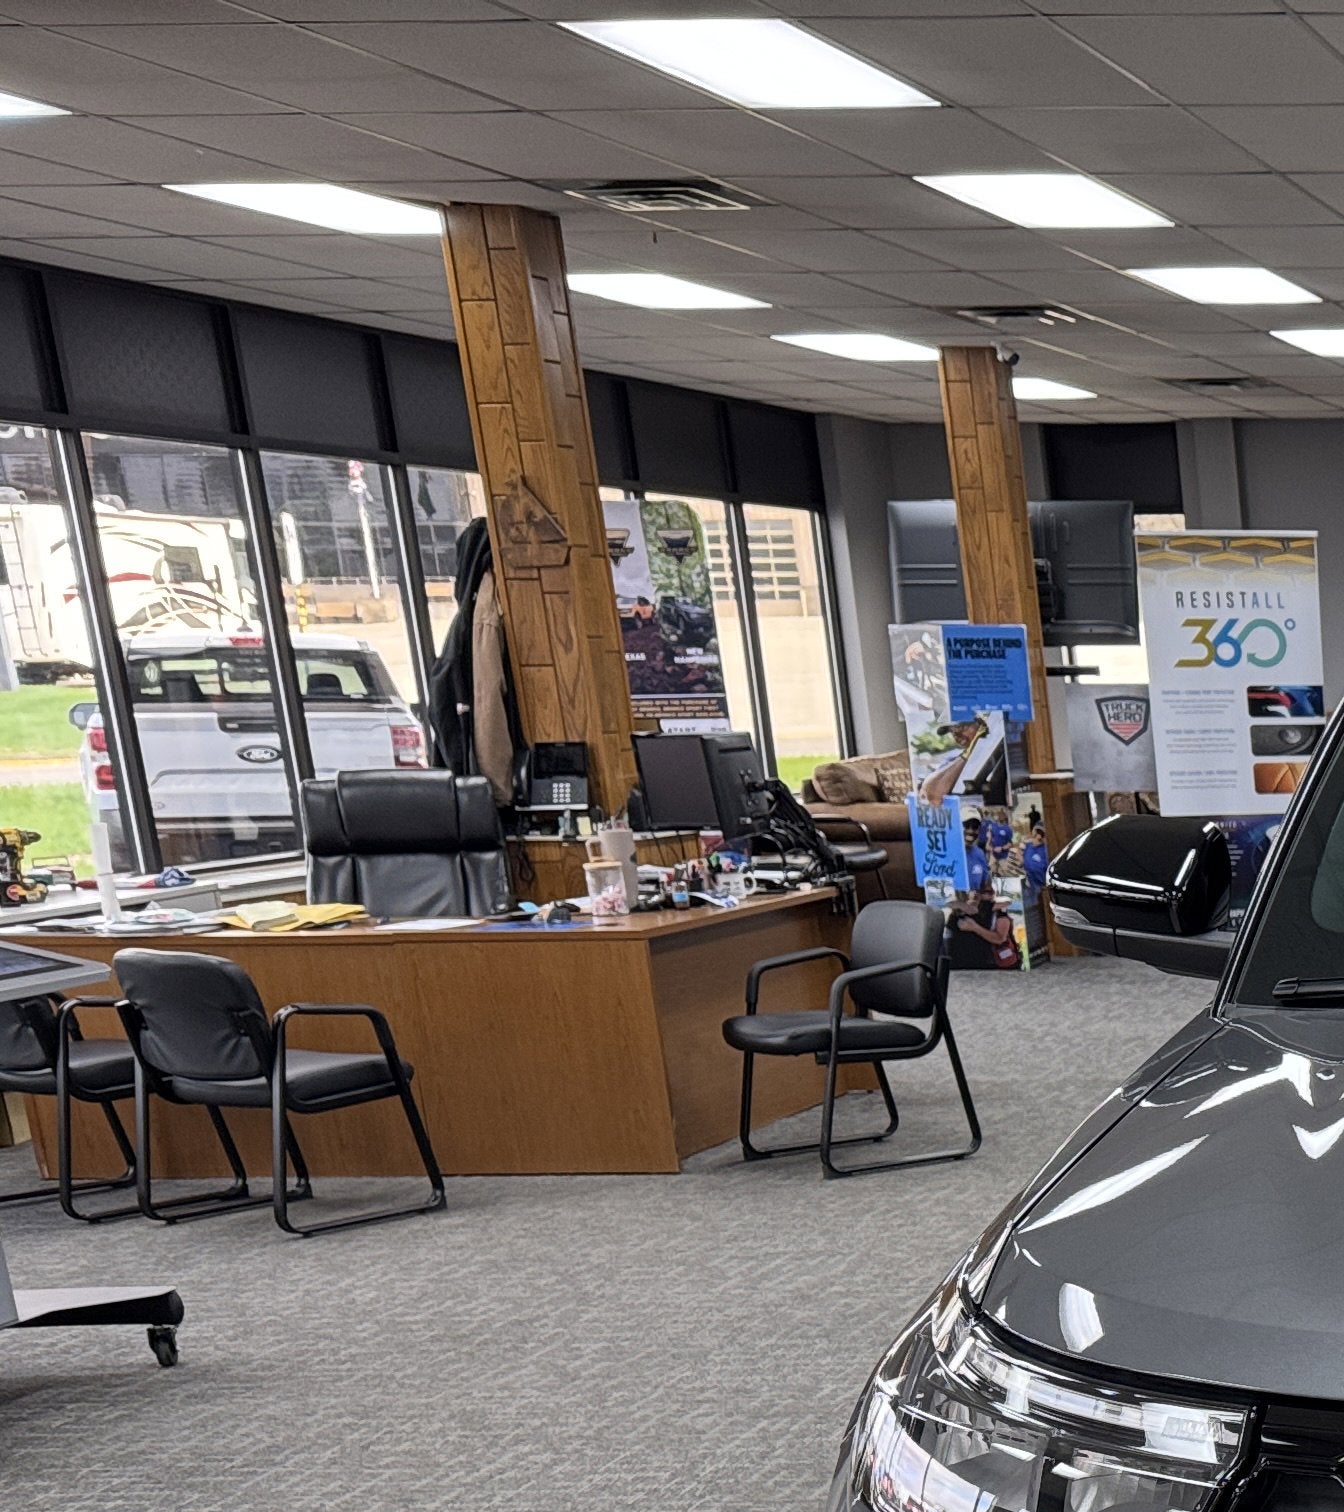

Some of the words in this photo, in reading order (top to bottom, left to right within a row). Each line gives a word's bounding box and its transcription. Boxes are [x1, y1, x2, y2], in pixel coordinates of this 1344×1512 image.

[1175, 591, 1285, 609] RESISTALL
[1103, 702, 1143, 713] TRUCK
[1107, 711, 1142, 722] HERO
[916, 806, 953, 829] READY
[927, 830, 947, 852] SET
